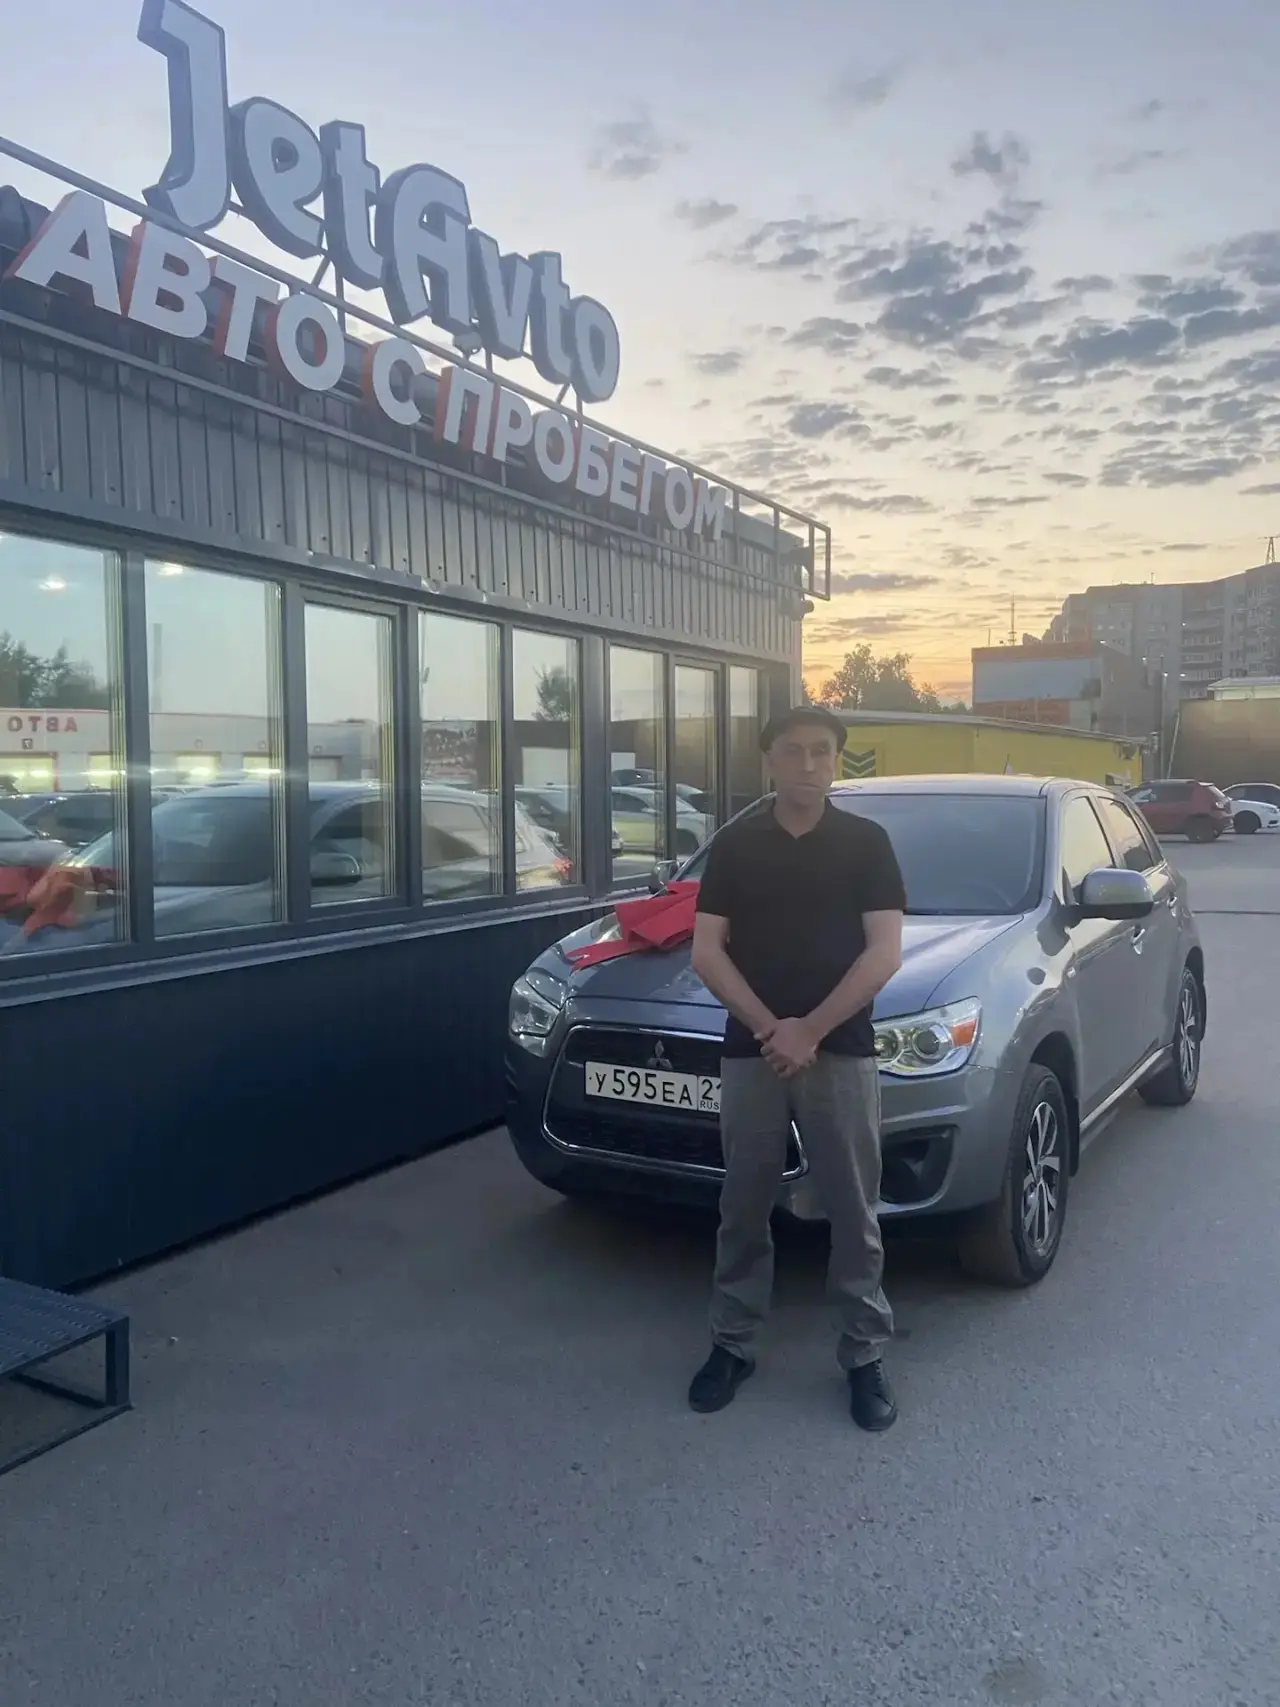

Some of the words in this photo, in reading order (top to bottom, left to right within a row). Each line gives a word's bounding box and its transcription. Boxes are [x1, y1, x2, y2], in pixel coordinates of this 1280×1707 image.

[138, 0, 620, 403] JetAvto
[9, 190, 344, 390] АВТО
[365, 339, 423, 426] С
[436, 366, 726, 541] ПРОБЕГОМ
[700, 1100, 720, 1110] RUS
[702, 1079, 721, 1100] 2
